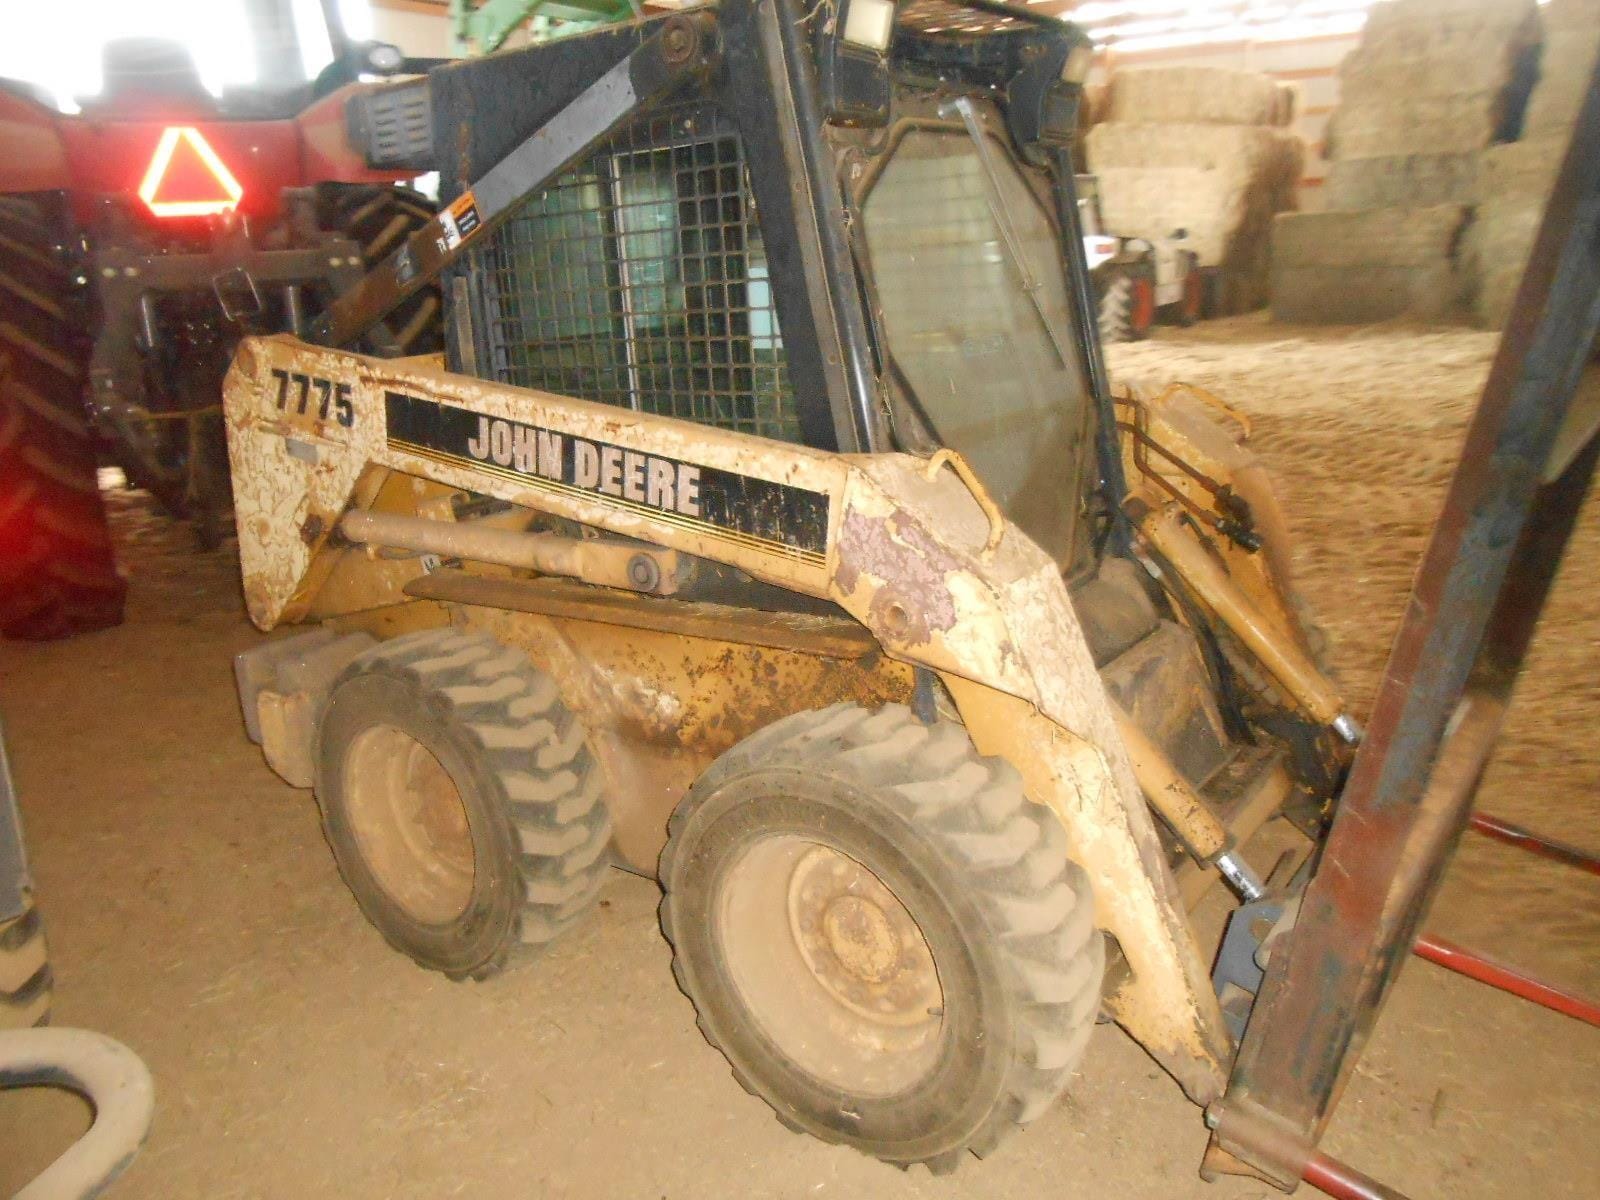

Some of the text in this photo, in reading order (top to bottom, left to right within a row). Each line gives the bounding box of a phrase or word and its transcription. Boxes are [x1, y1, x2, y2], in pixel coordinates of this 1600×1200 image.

[272, 370, 354, 427] 7775
[469, 417, 701, 516] JOHN DEERE
